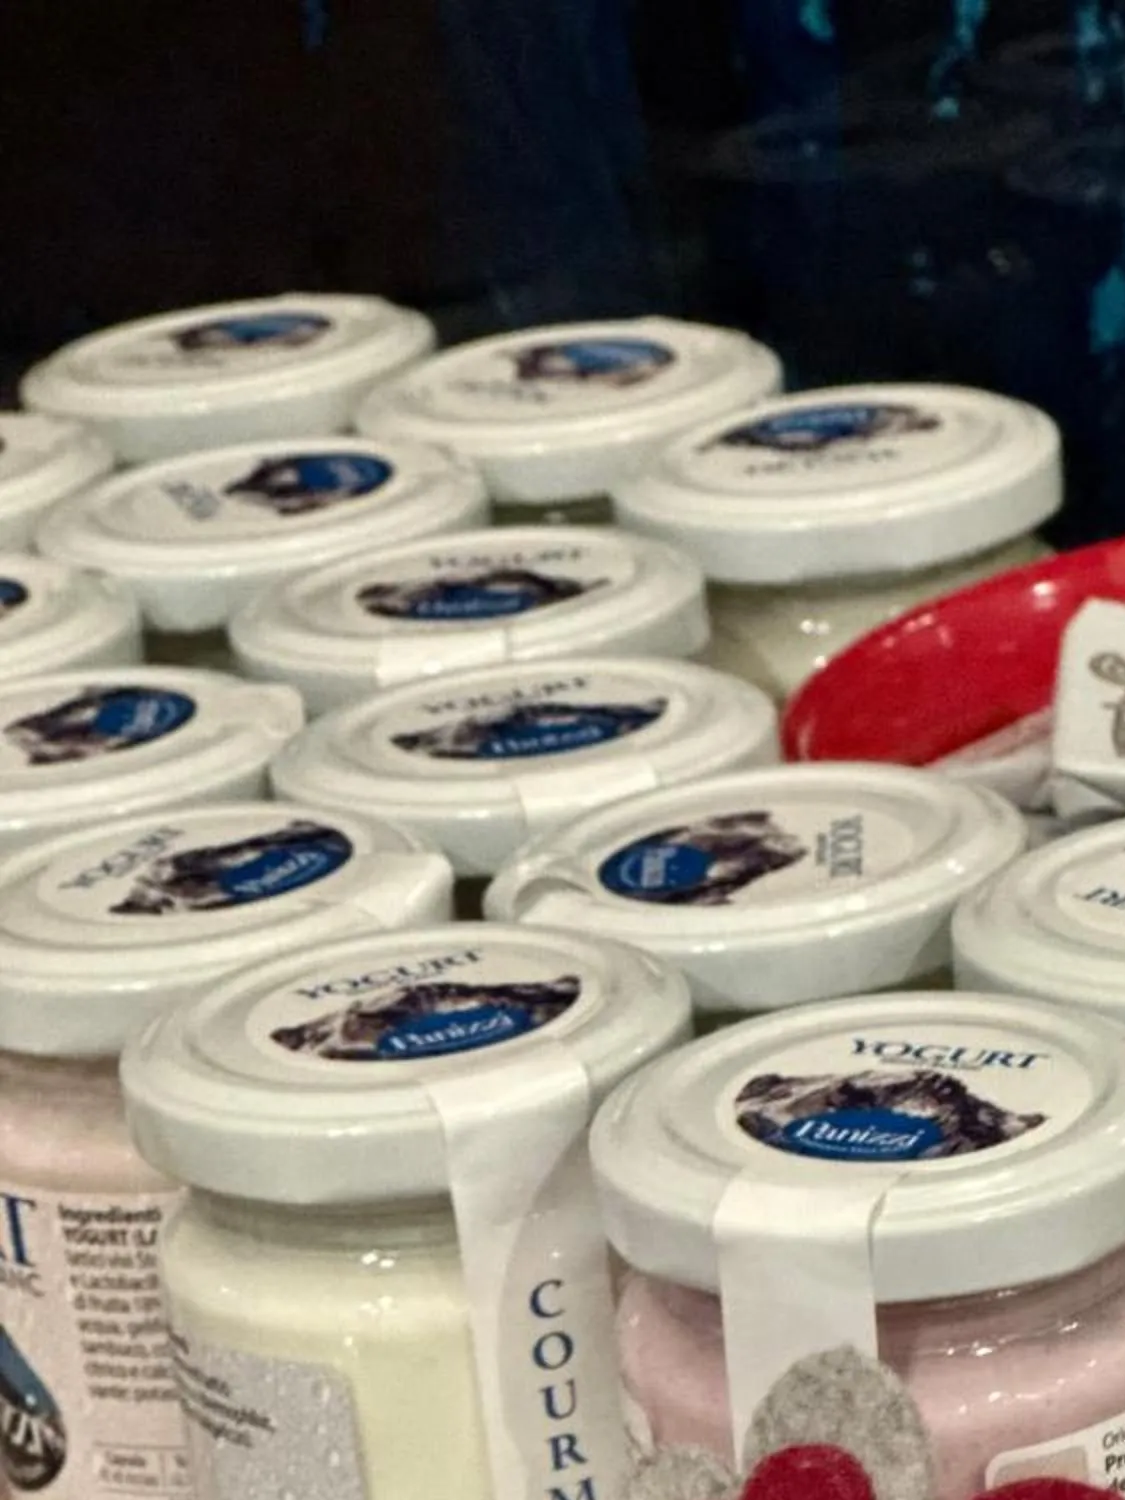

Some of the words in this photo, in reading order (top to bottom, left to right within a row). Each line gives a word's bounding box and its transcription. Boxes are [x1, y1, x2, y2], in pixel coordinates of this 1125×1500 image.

[296, 949, 483, 1000] YOGURT
[852, 1037, 1050, 1070] YOGURT
[793, 1118, 925, 1150] Panizzi
